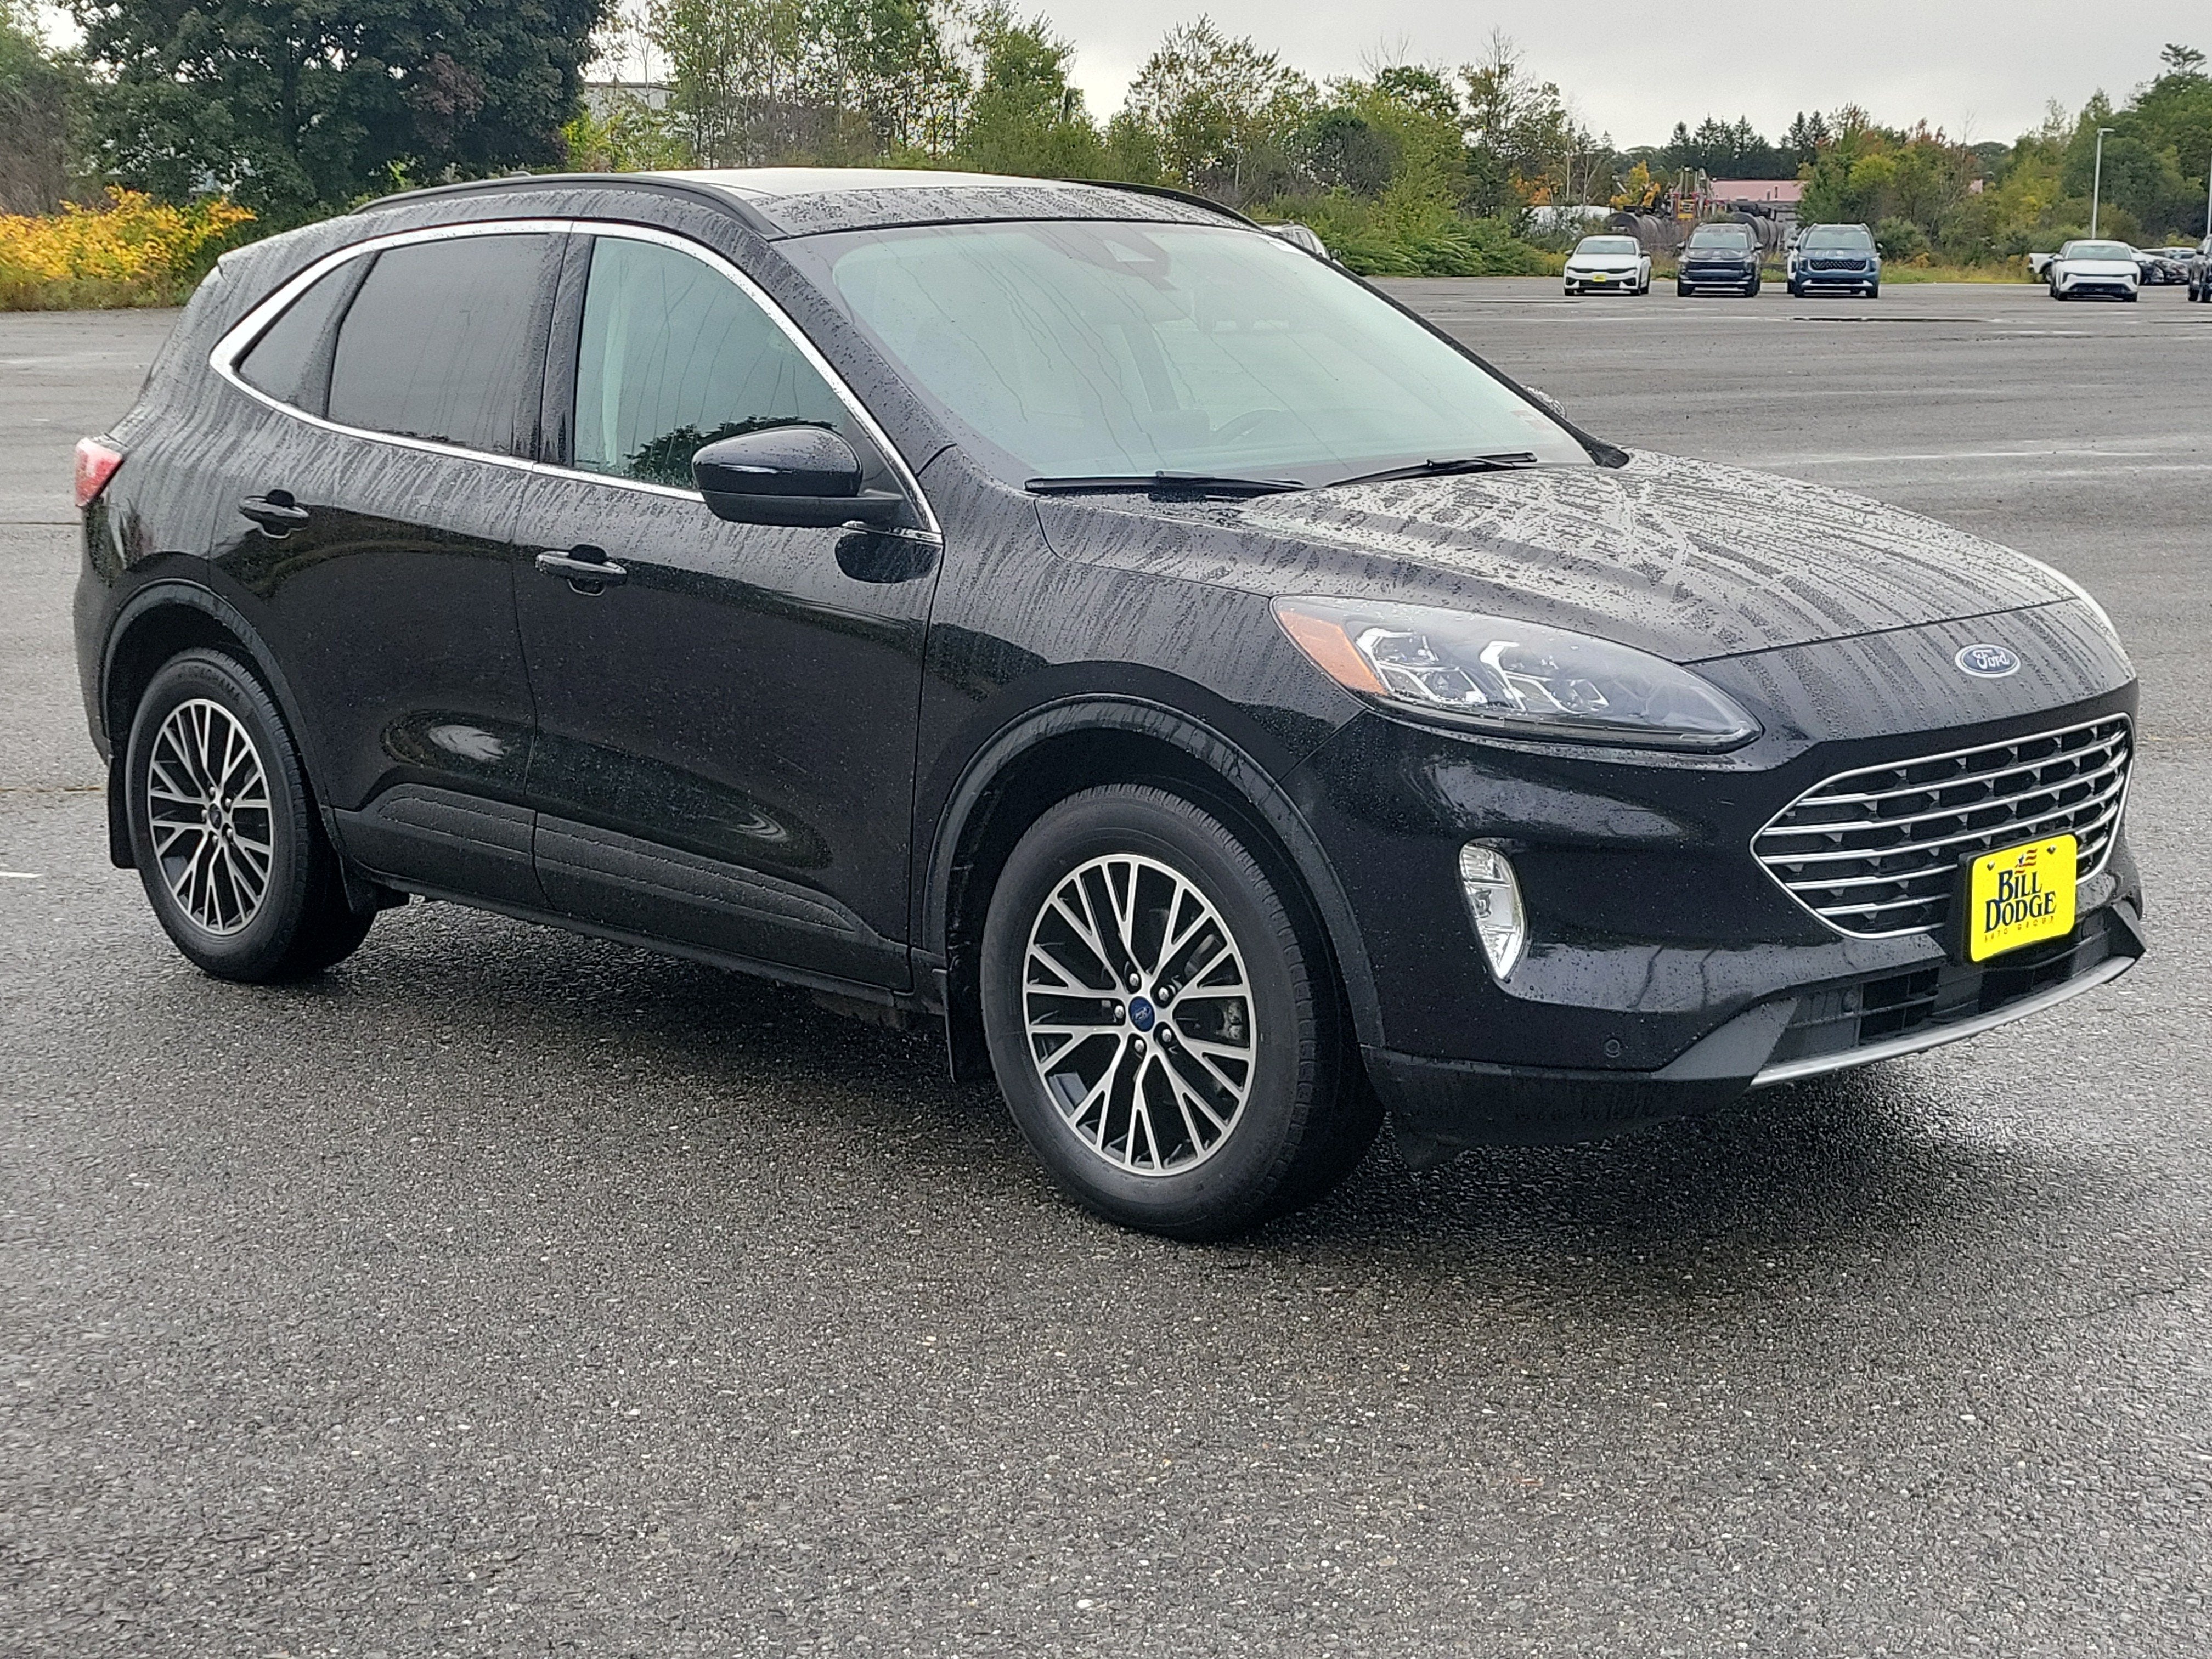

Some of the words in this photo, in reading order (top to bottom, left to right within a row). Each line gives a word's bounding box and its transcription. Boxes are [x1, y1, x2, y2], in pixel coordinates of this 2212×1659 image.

[1972, 648, 2010, 670] Ford
[1998, 868, 2042, 904] BILL
[1984, 891, 2057, 933] DODGE
